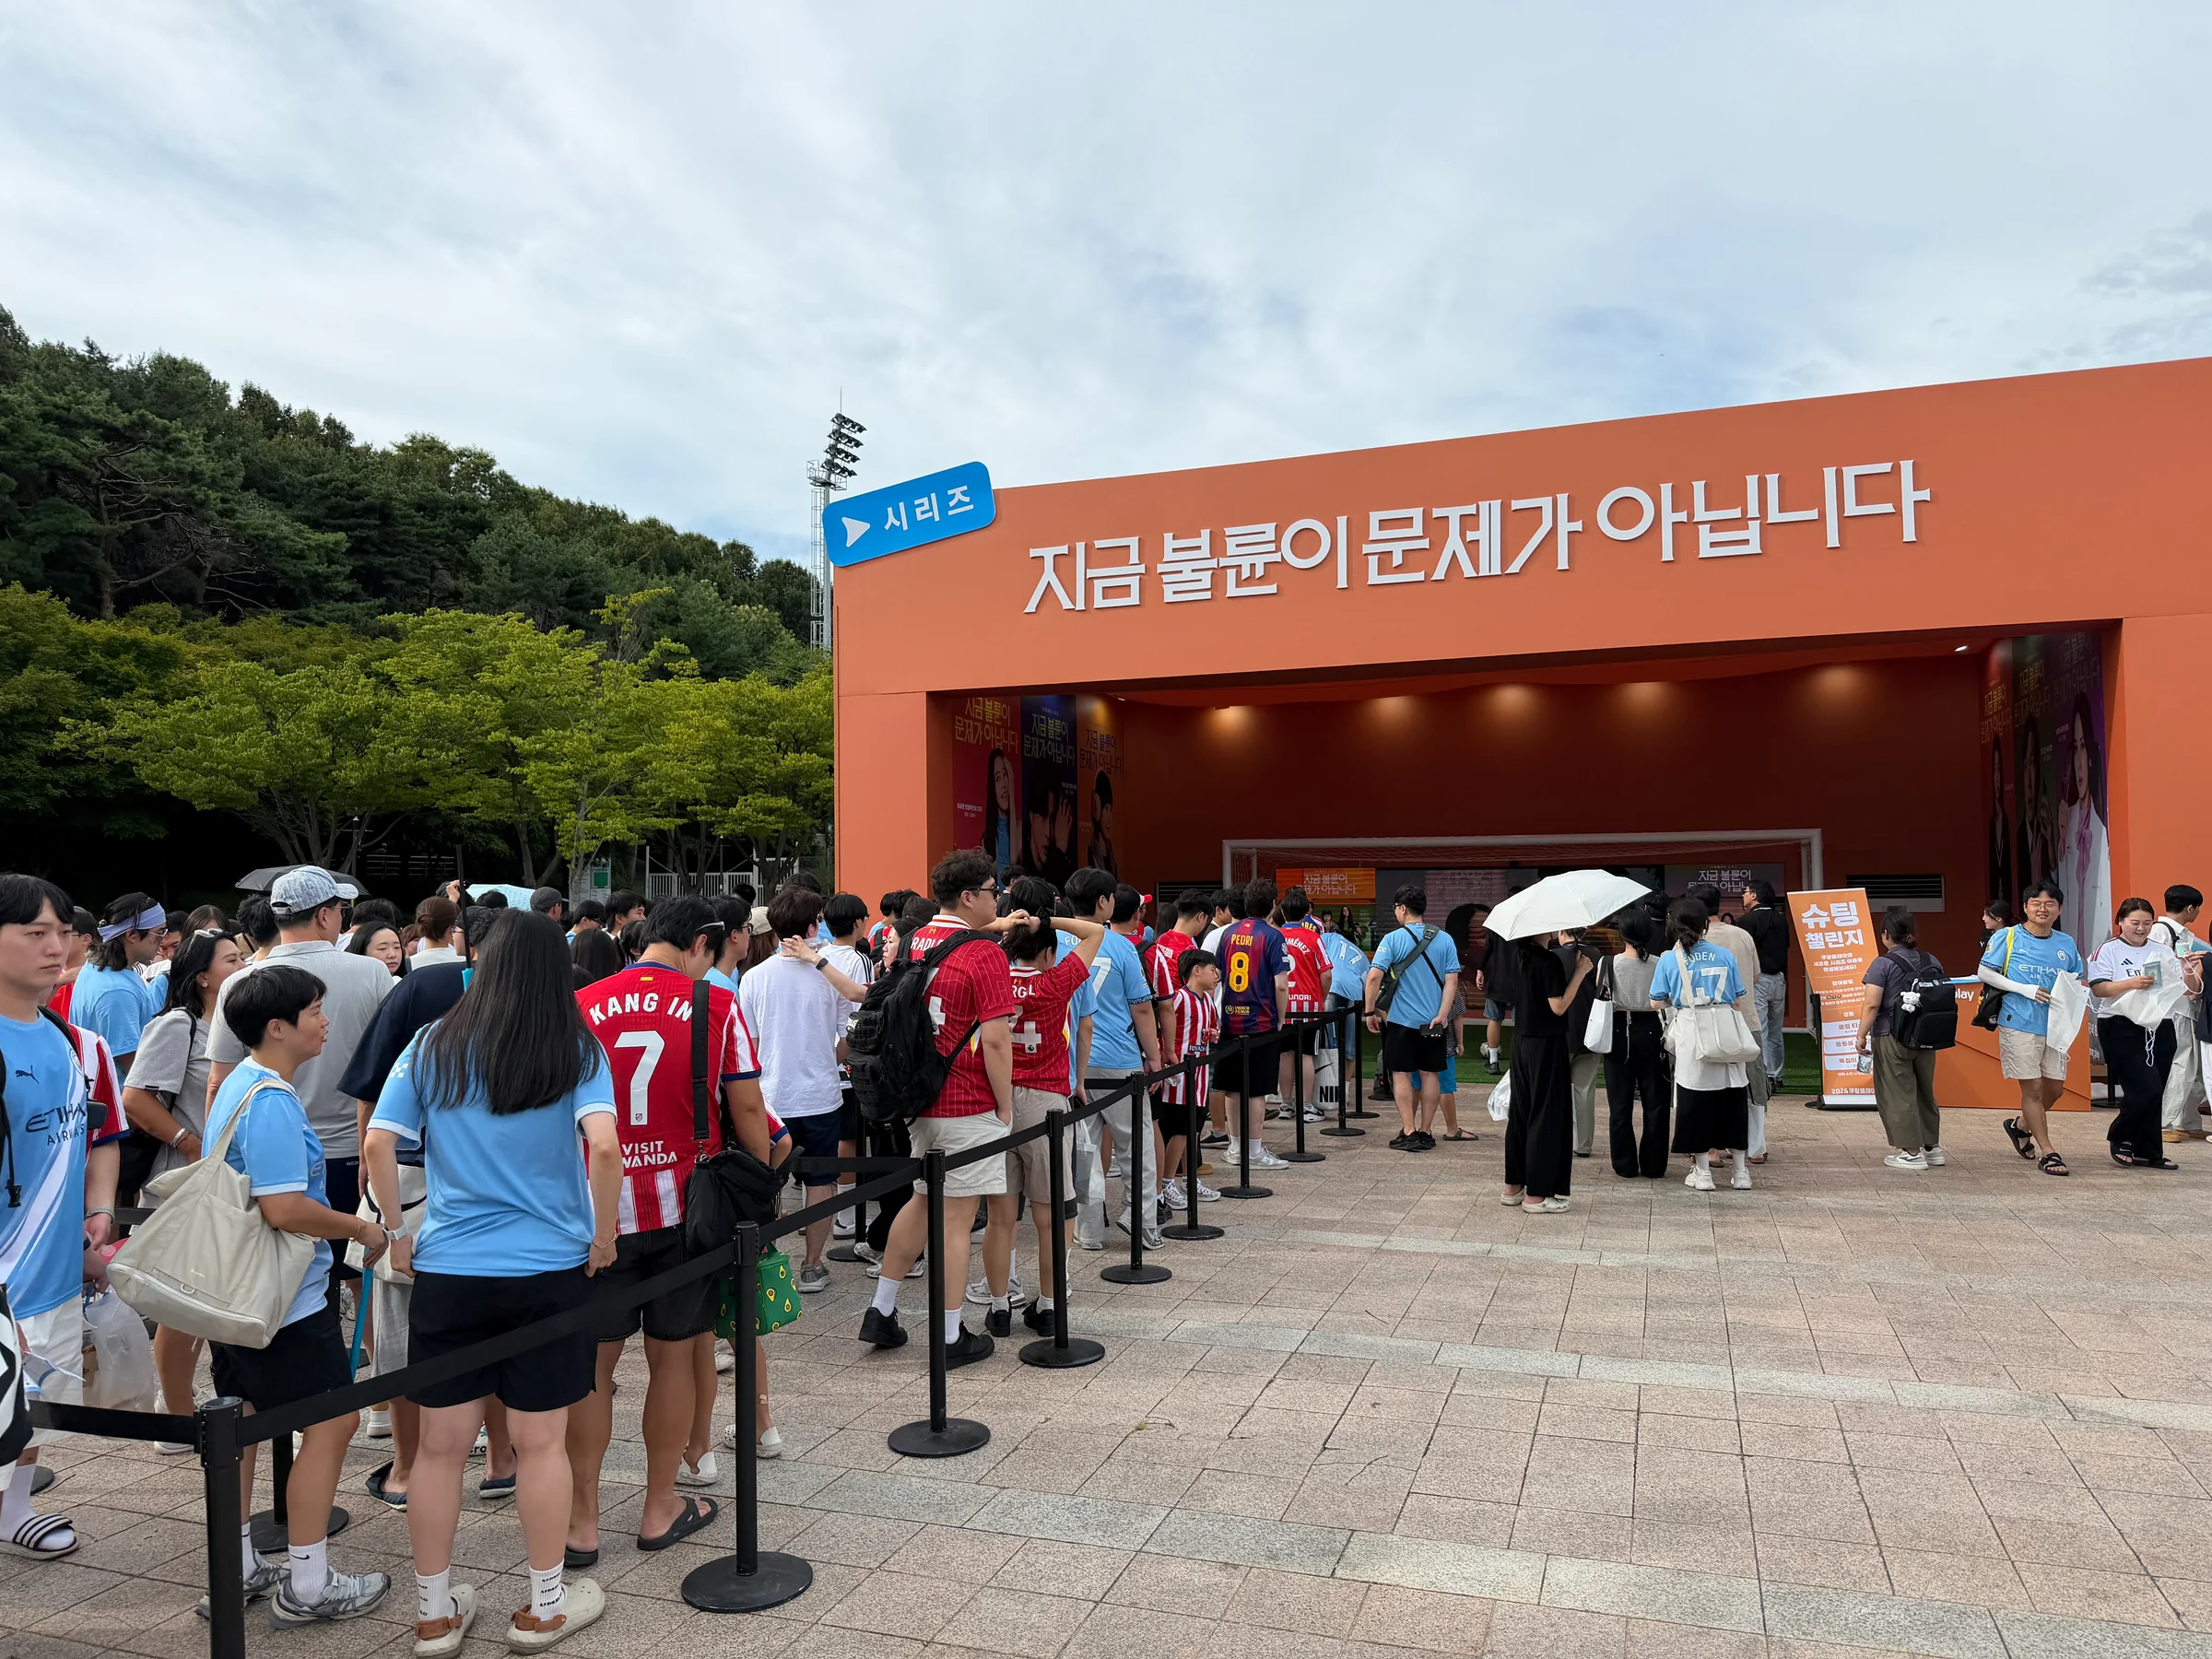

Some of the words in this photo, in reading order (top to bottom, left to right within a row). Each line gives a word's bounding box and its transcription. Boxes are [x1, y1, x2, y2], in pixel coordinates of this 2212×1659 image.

[883, 485, 974, 533] 시리즈
[1023, 535, 1146, 614] 지금
[1157, 514, 1349, 604] 불륜이
[1361, 492, 1583, 585] 문제가
[1596, 459, 1931, 562] 아닙니다
[984, 698, 1010, 727] 불륜이
[955, 715, 983, 746] 문제가
[983, 724, 1018, 754] 아닙니다
[1031, 712, 1047, 736] 지금
[1047, 716, 1068, 743] 불륜이
[1023, 734, 1046, 759] 문제가
[1046, 740, 1076, 766] 아닙니다
[1086, 728, 1098, 749] 지금
[1100, 733, 1117, 756] 불륜이
[1079, 747, 1098, 771] 문제가
[1099, 753, 1122, 775] 아닙니다
[1303, 874, 1320, 884] 지금
[1323, 874, 1347, 884] 불륜이
[1699, 870, 1719, 881] 지금
[1721, 869, 1751, 881] 불륜이
[1321, 884, 1357, 895] 아닙니다
[1801, 900, 1860, 929] 슈팅
[1065, 935, 1081, 946] FO
[1230, 934, 1253, 947] PEDRI
[1339, 940, 1362, 965] 17
[1805, 929, 1864, 949] 챌린지
[1229, 951, 1249, 993] 8
[589, 993, 659, 1026] KANG
[667, 996, 693, 1022] IN
[614, 1030, 665, 1126] 7
[621, 1140, 664, 1156] VISIT
[470, 1445, 487, 1453] ro
